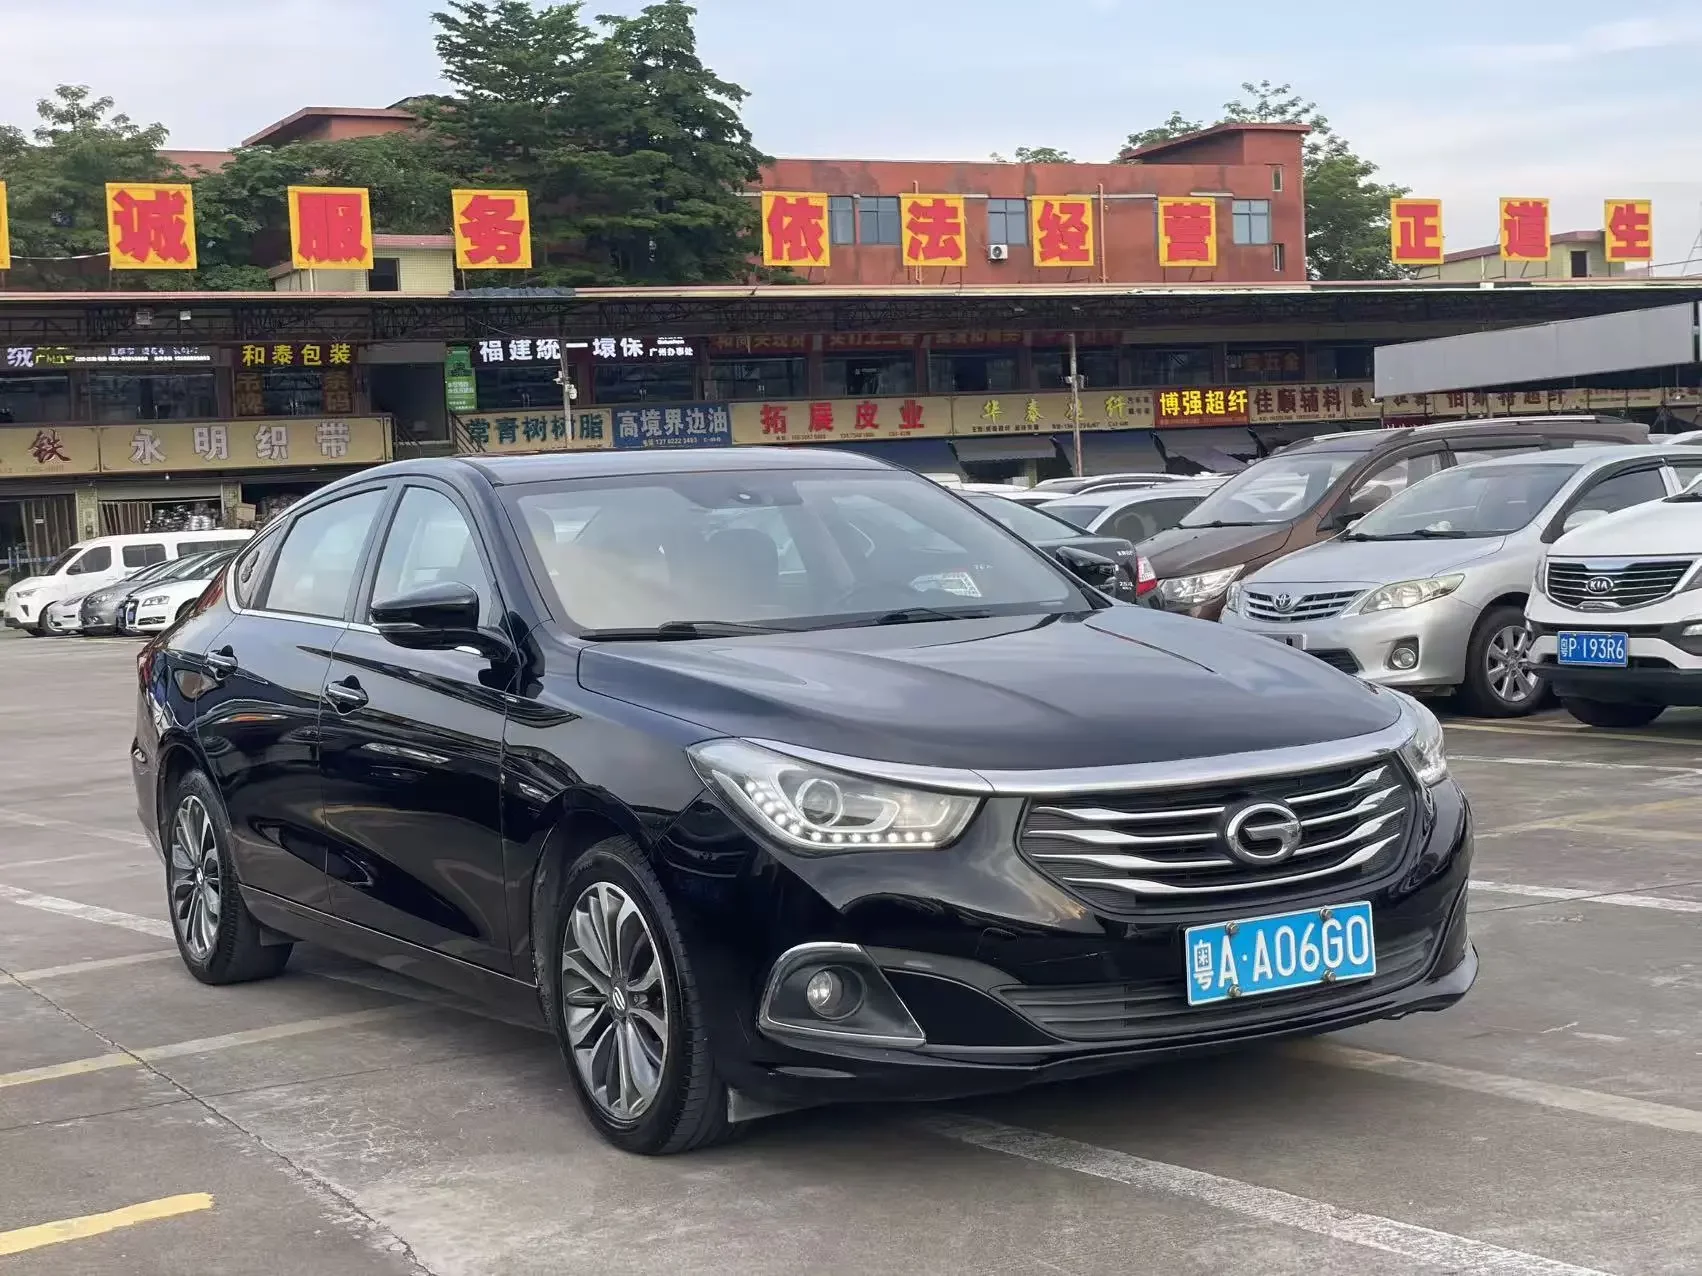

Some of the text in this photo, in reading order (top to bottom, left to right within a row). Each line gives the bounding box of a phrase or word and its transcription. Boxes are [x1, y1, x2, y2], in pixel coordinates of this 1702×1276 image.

[242, 343, 351, 367] 和泰包装
[760, 399, 925, 435] 拓展皮业
[1159, 388, 1249, 416] 博强超纤
[617, 406, 728, 438] 高境界边油
[128, 419, 351, 466] 永明织带
[1590, 580, 1608, 591] KIA
